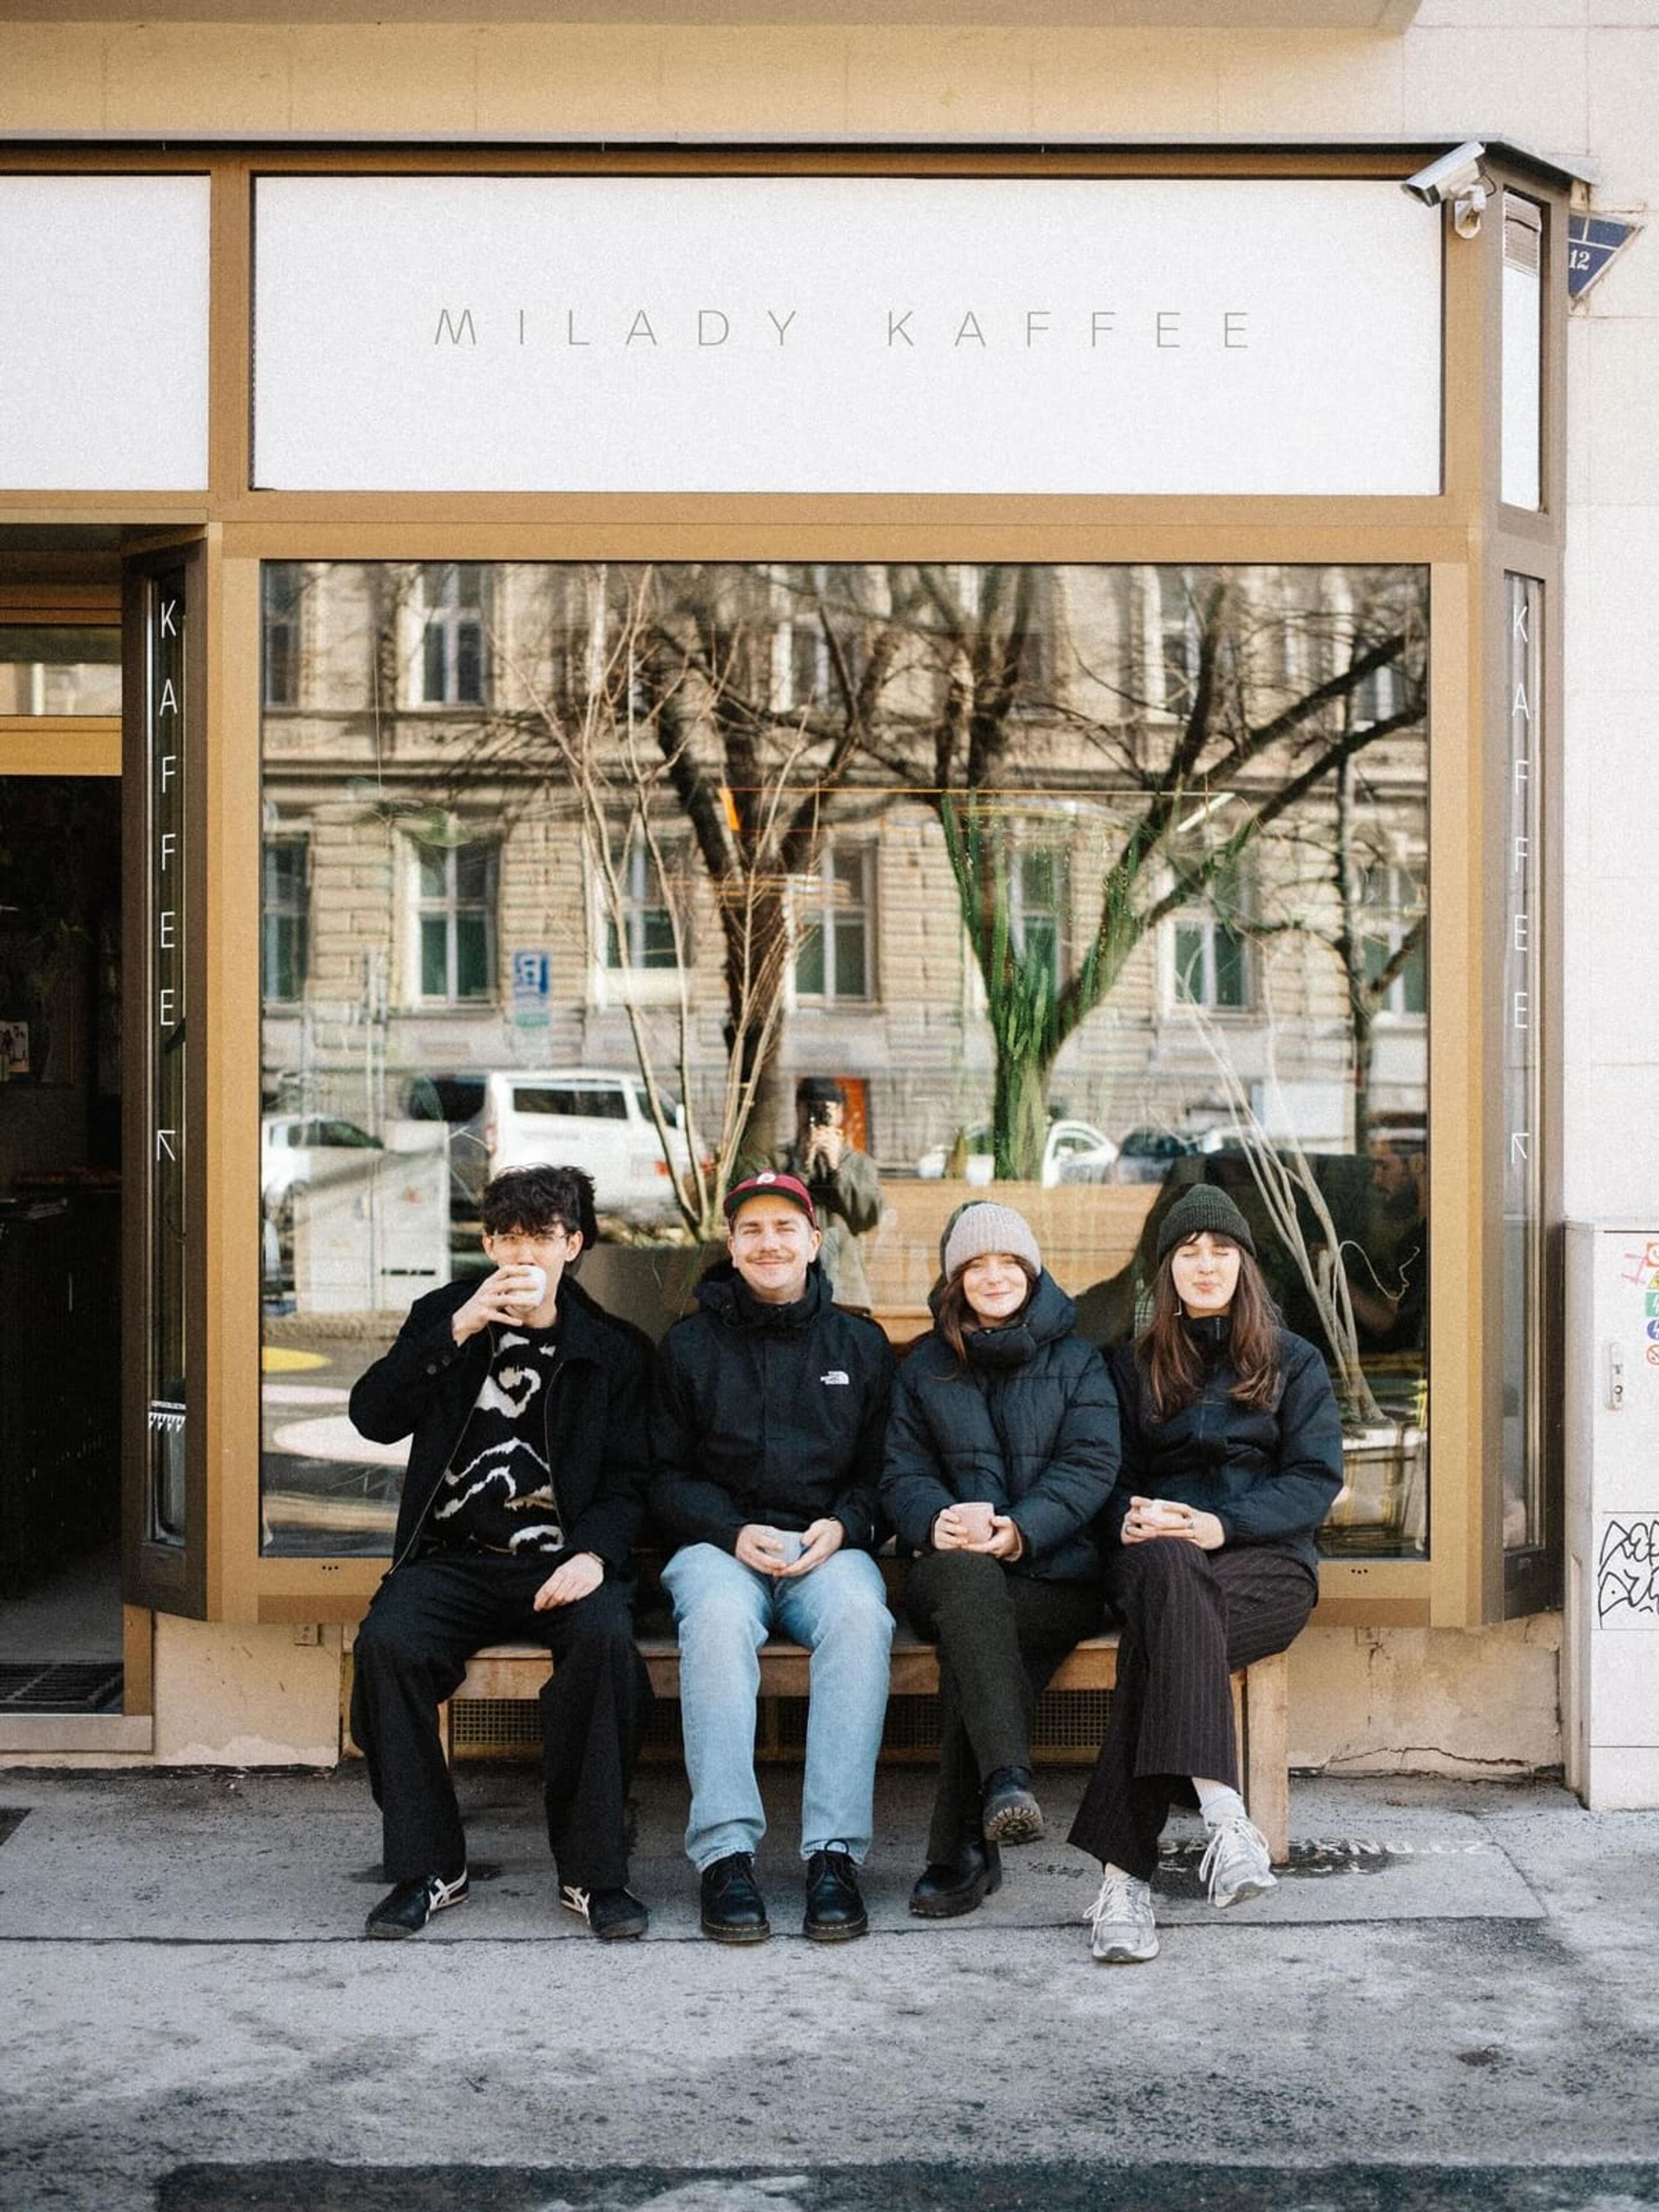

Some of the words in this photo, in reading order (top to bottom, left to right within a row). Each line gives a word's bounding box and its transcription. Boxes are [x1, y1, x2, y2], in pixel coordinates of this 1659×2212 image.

[435, 308, 796, 346] MILADY
[888, 311, 1246, 348] KAFFEE
[1568, 249, 1590, 270] 12
[159, 599, 178, 1026] KAFFEE
[1512, 603, 1530, 1029] KAFFEE
